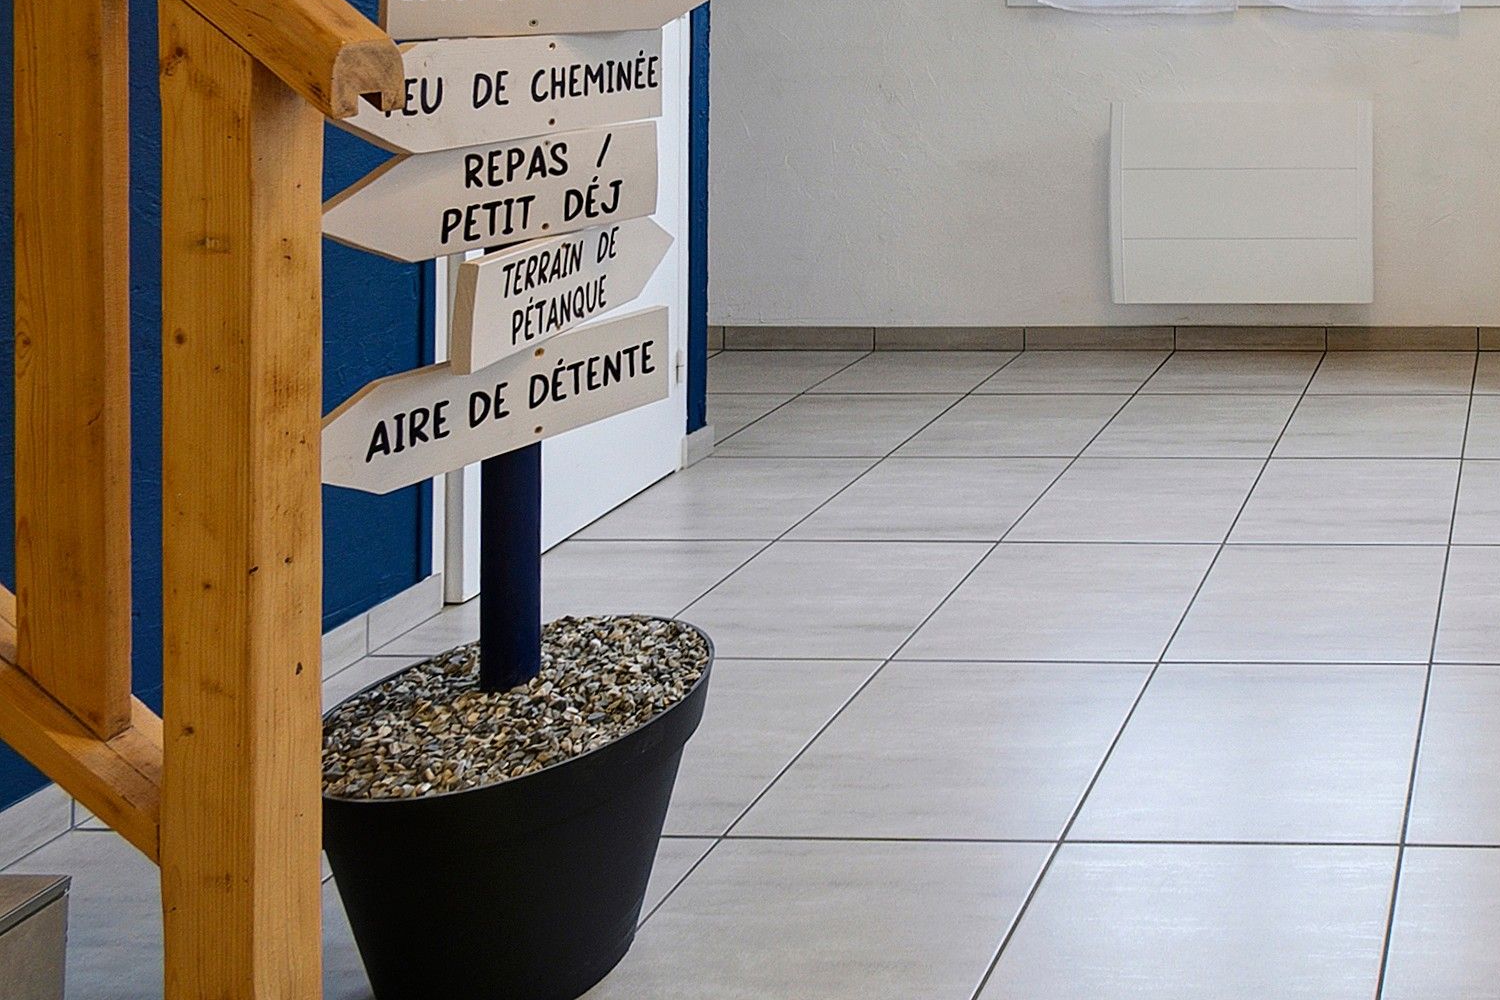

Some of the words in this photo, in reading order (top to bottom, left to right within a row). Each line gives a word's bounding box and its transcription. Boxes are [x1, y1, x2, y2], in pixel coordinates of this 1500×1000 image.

[385, 77, 443, 117] EU
[473, 70, 509, 110] DE
[531, 50, 659, 103] CHEMINÉE
[465, 142, 569, 188] REPAS
[441, 195, 535, 244] PETIT
[564, 175, 623, 220] DÉJ
[503, 240, 583, 299] TERRAIN
[597, 227, 619, 261] DE
[513, 275, 607, 345] PÉTANQUE
[365, 400, 450, 463] AIRE
[469, 382, 509, 425] DE
[529, 341, 656, 409] DÉTENTE
